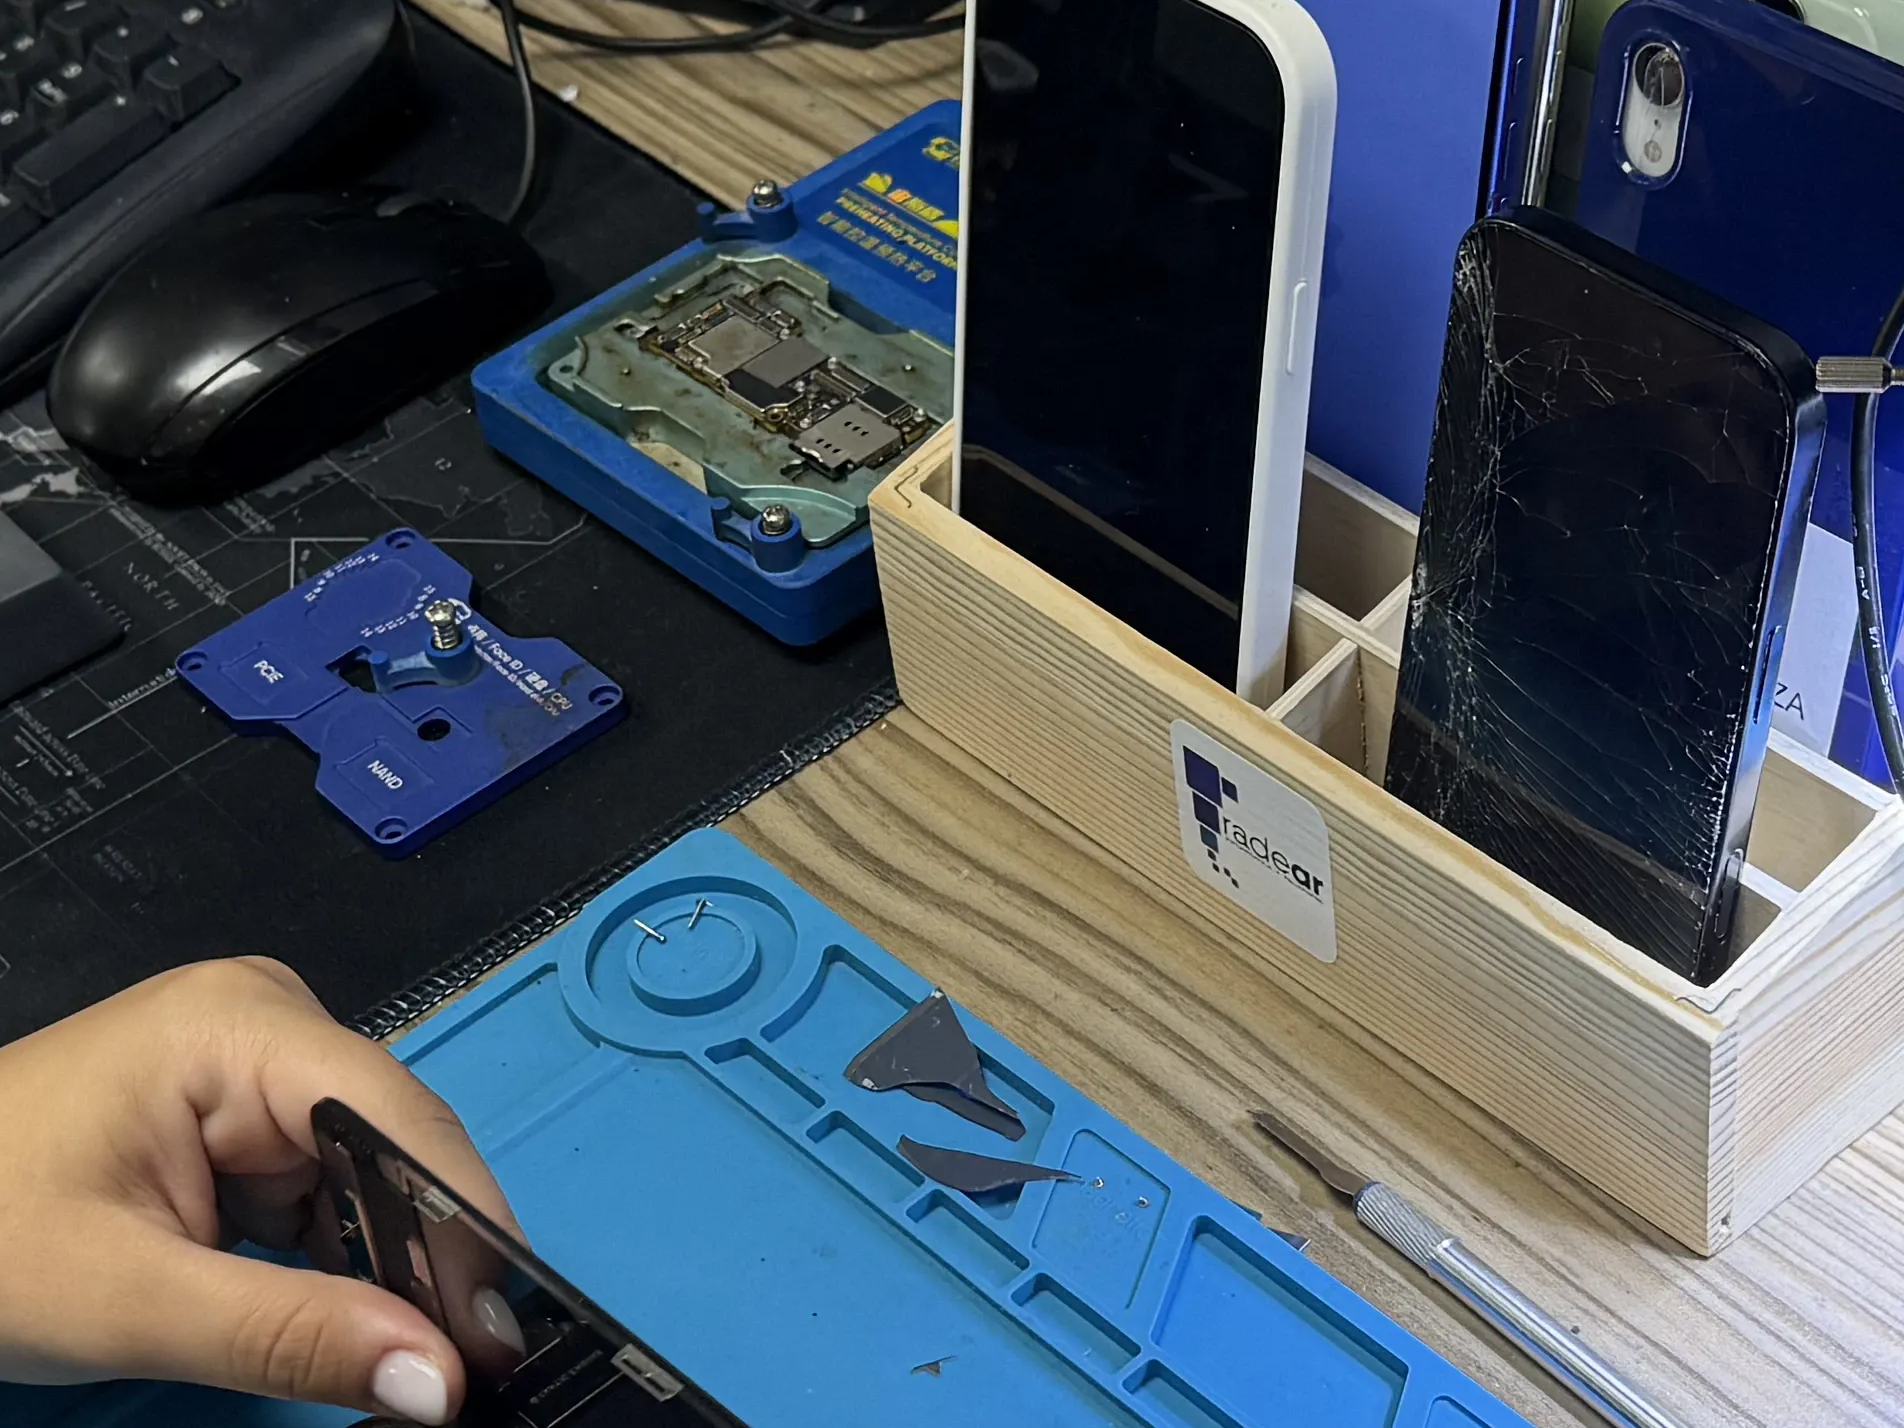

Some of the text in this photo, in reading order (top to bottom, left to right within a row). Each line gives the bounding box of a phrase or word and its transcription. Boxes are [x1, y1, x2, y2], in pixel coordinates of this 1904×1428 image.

[835, 196, 904, 238] PREHEATING
[488, 641, 513, 663] Face
[550, 691, 573, 712] CPU
[367, 759, 404, 789] NAND
